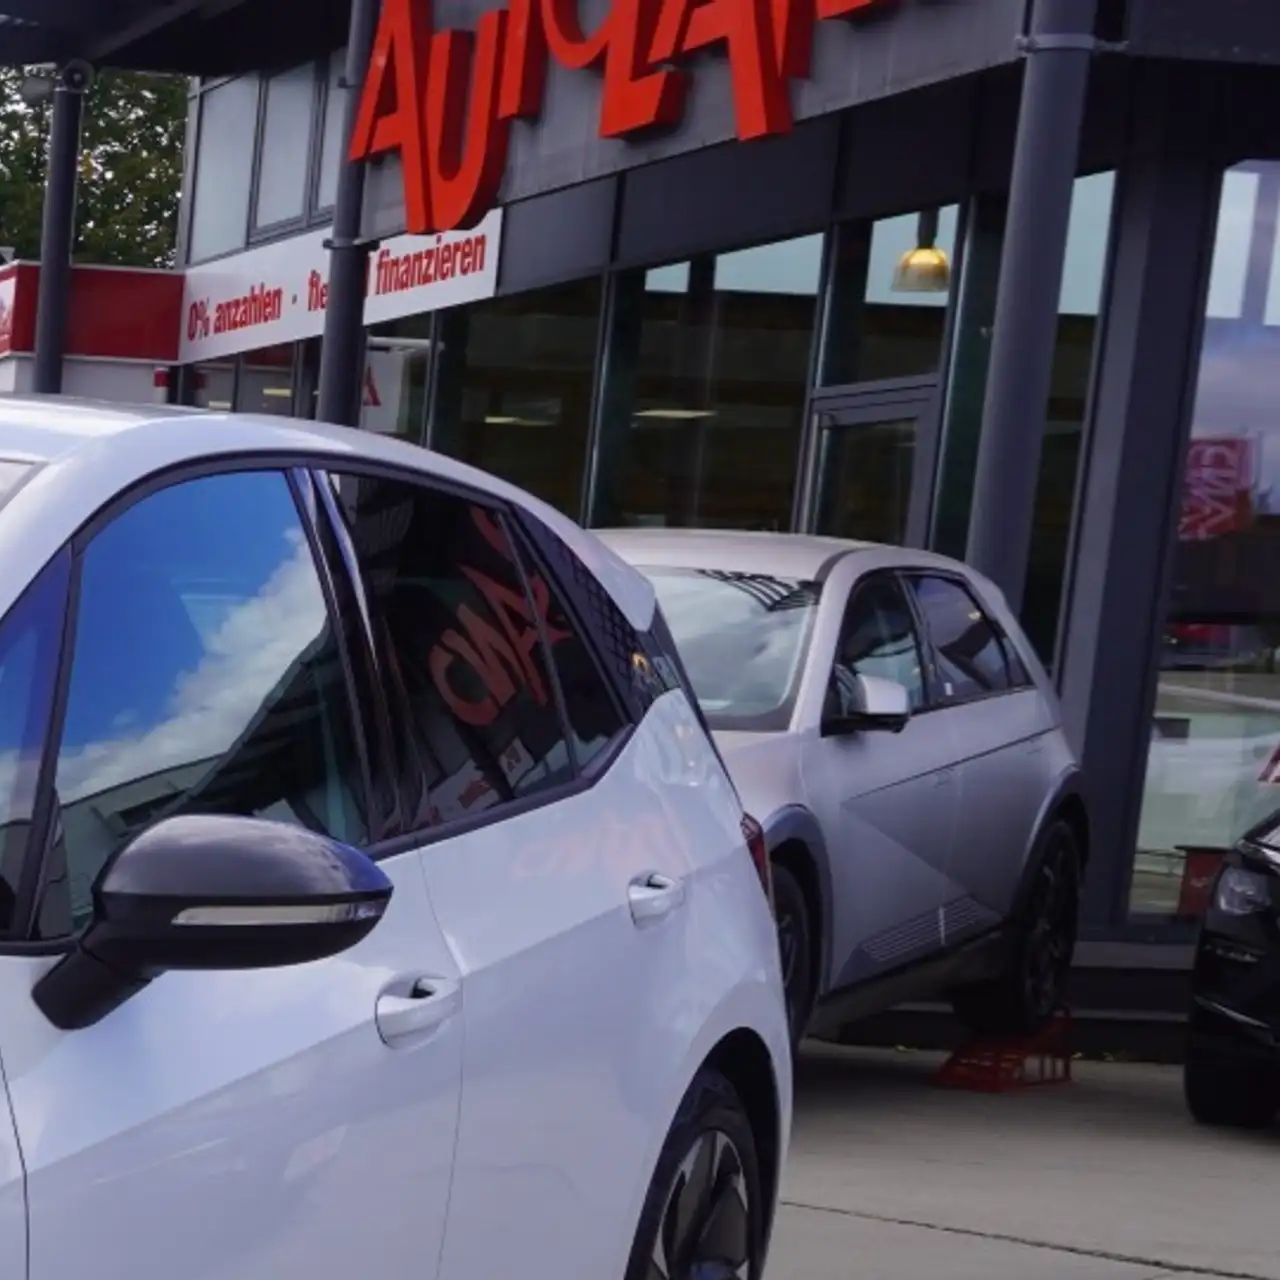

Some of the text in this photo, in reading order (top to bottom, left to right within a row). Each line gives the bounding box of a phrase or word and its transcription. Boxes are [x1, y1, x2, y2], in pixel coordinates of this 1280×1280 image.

[188, 297, 209, 341] 0%
[214, 282, 283, 335] anzahlen
[376, 234, 485, 295] finanzieren
